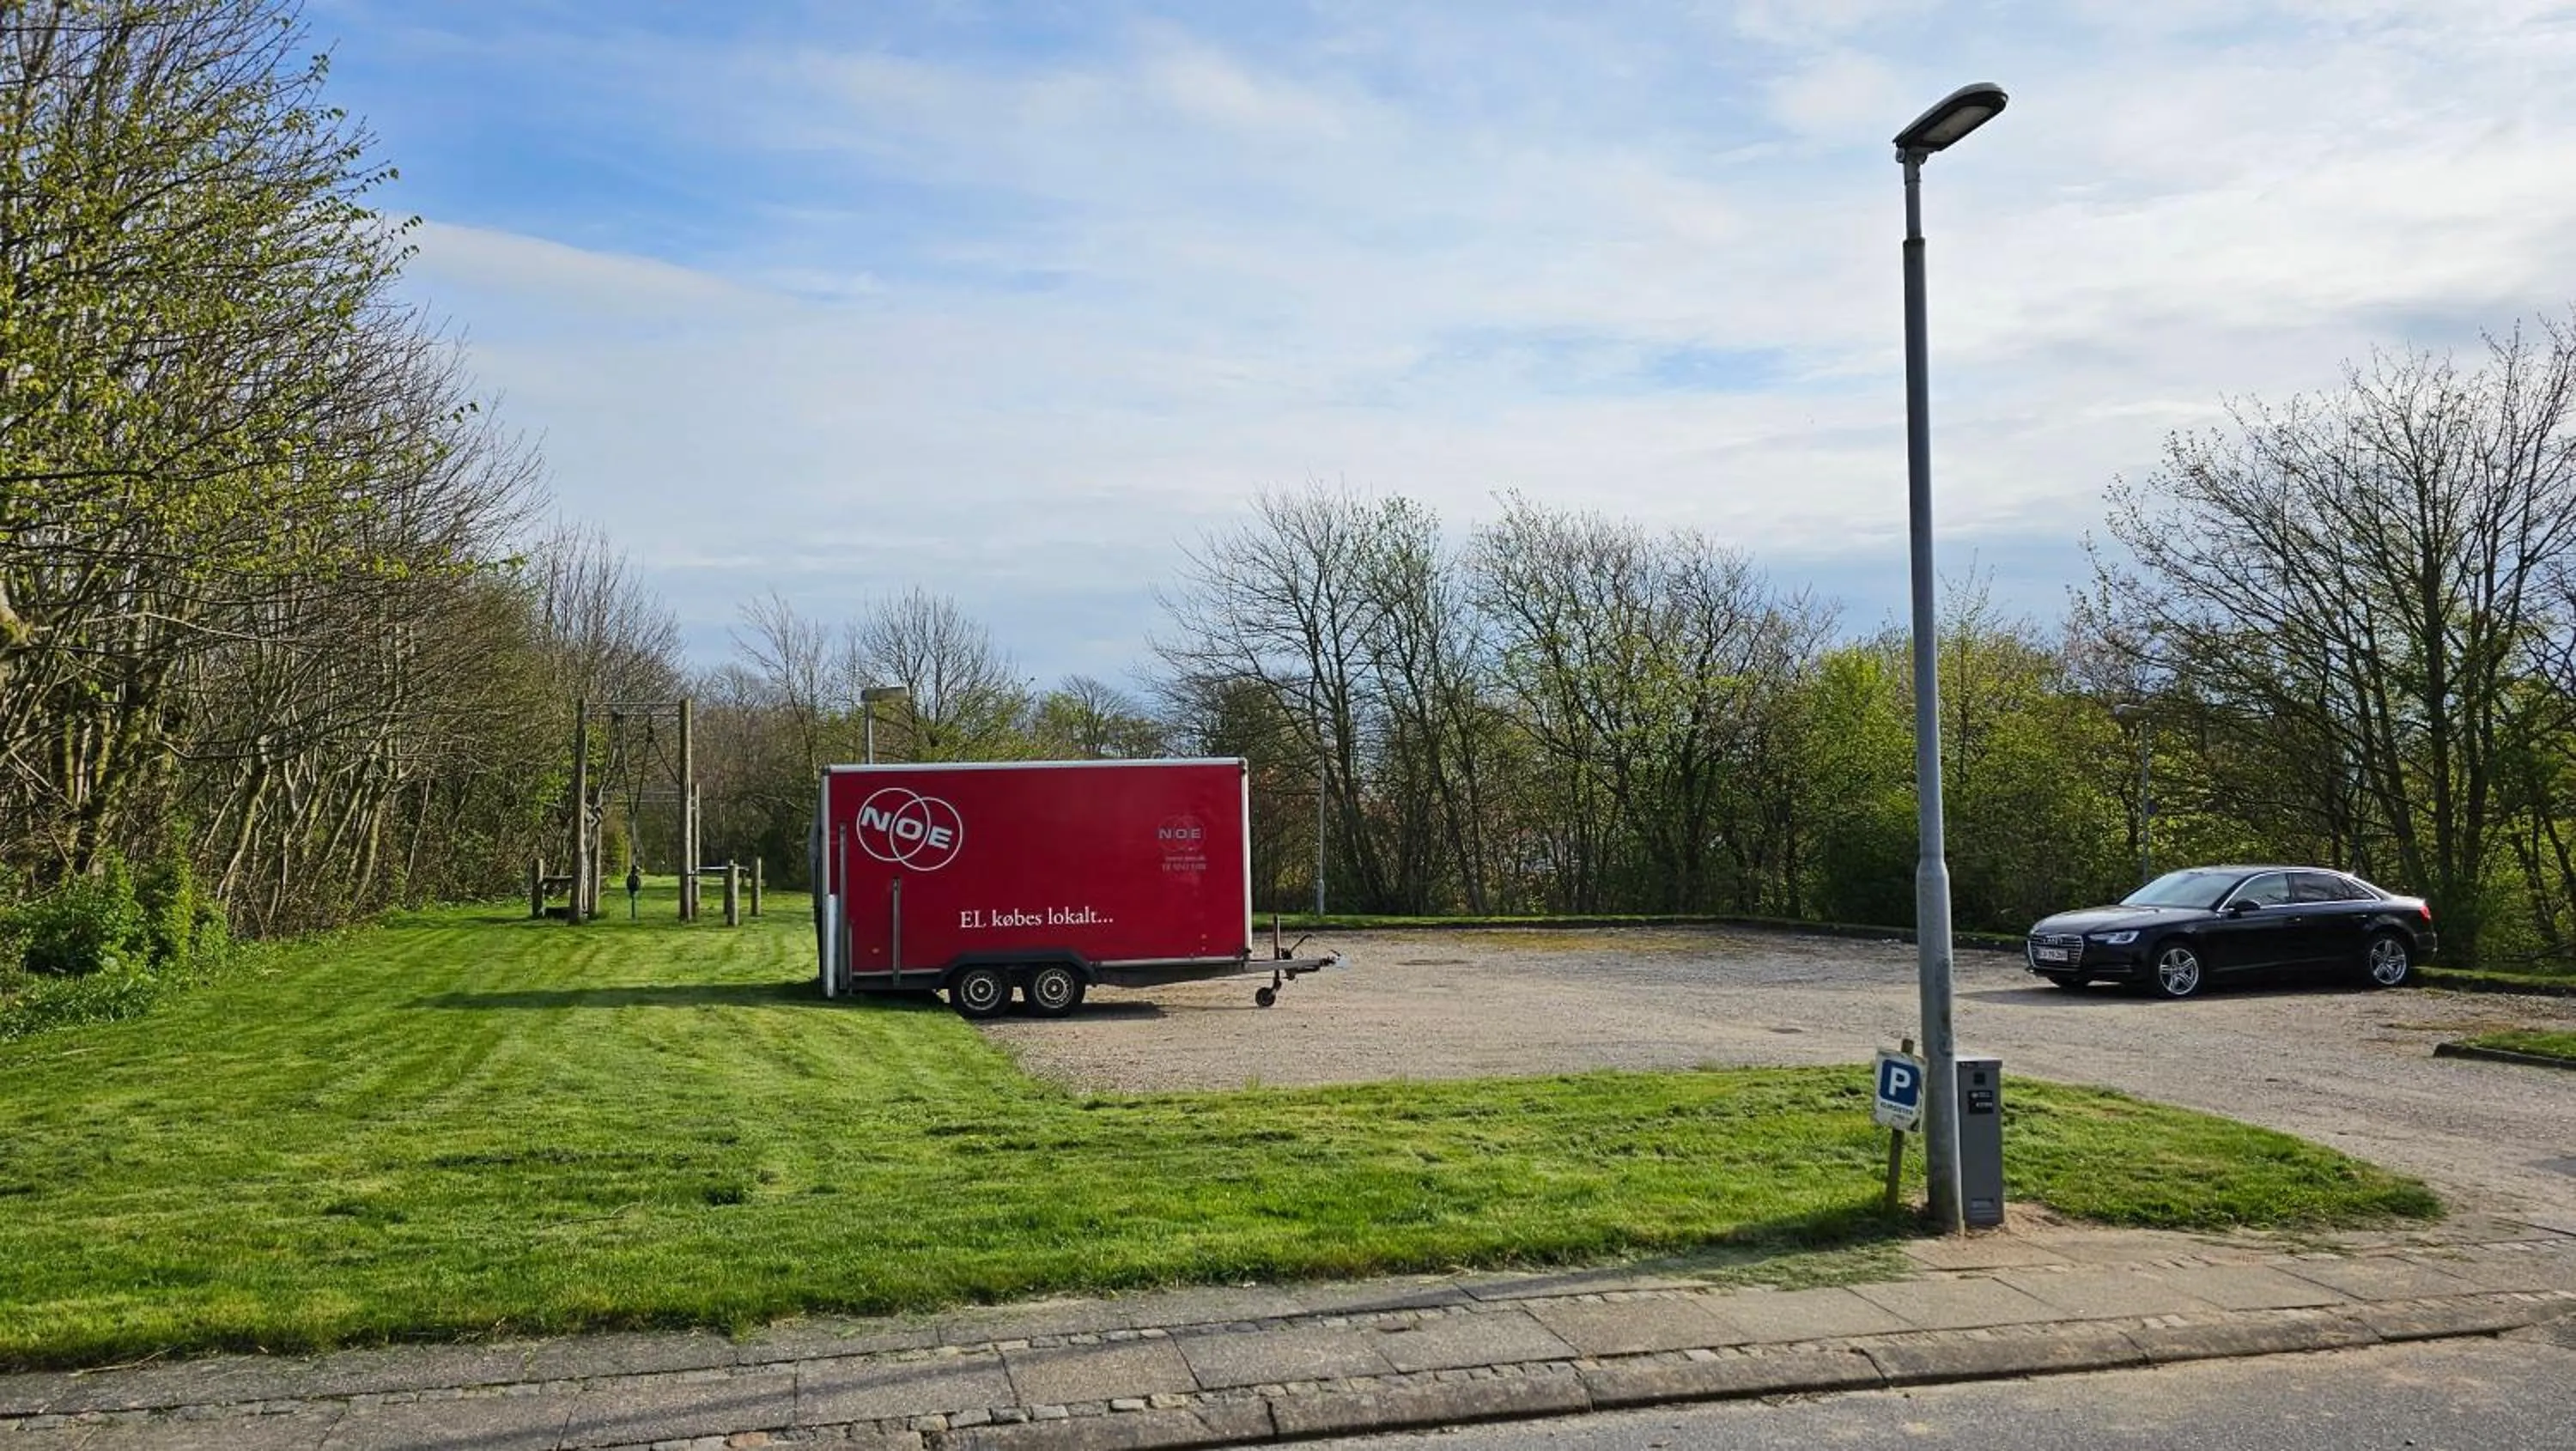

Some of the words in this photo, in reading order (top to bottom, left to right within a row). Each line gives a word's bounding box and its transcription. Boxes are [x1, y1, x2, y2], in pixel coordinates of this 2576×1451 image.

[860, 806, 953, 849] NOE
[1158, 828, 1201, 839] NOE
[960, 910, 987, 928] EL
[992, 908, 1042, 926] købes
[1048, 906, 1114, 925] lokalt...
[1888, 1066, 1911, 1096] P
